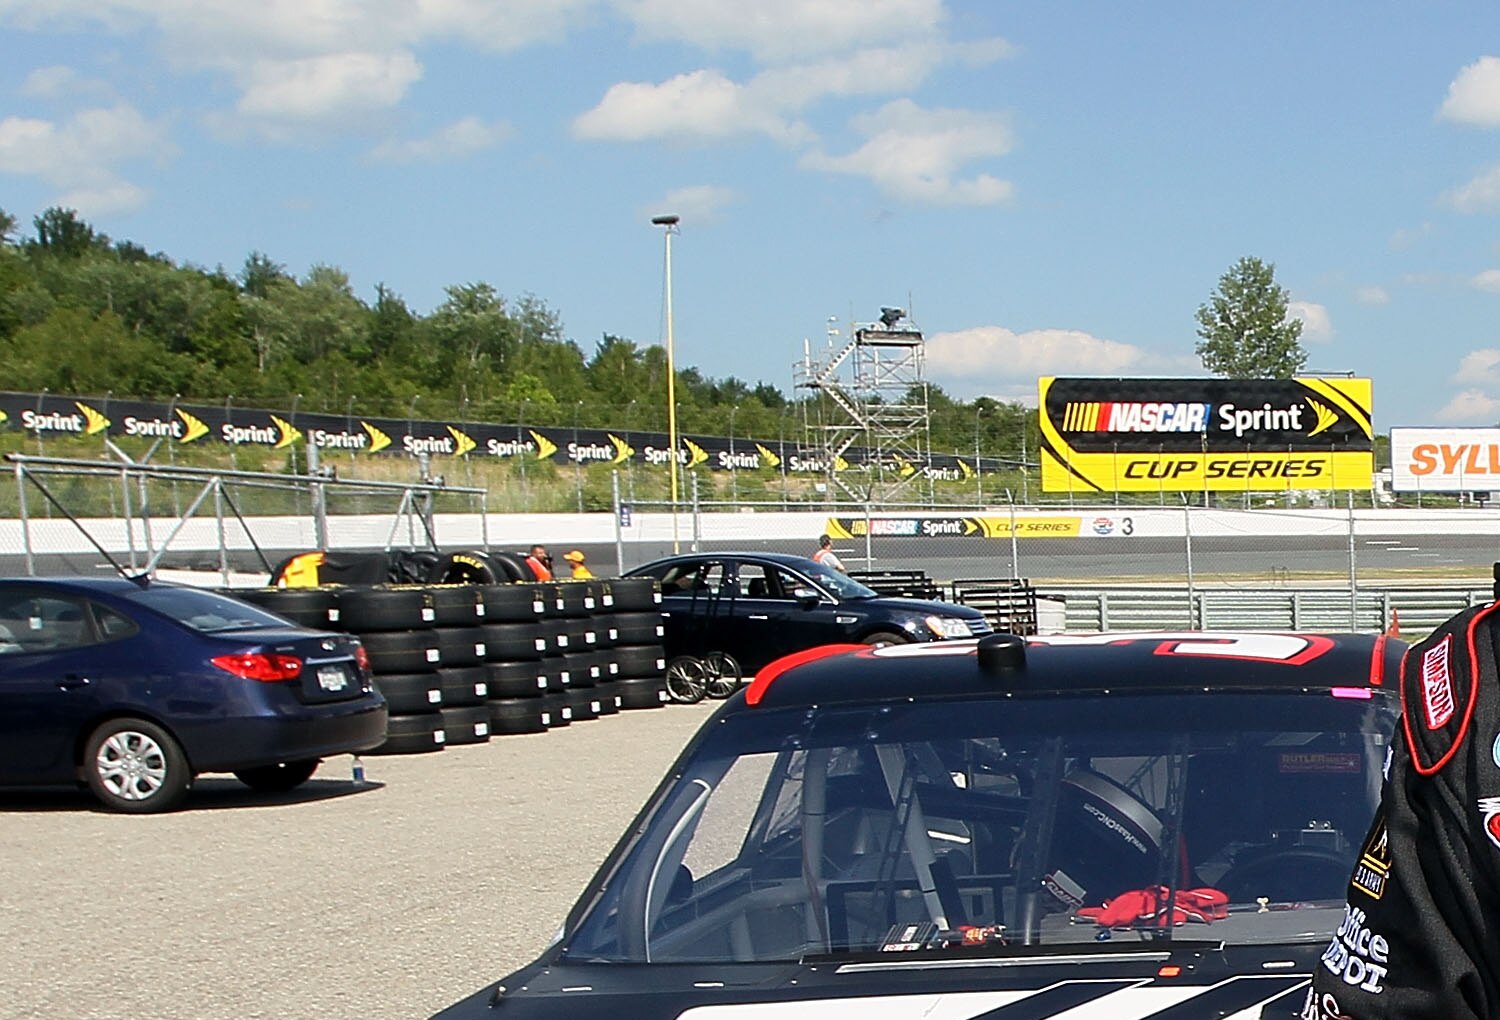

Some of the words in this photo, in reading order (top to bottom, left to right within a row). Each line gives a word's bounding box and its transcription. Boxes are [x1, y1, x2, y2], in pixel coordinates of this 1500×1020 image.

[21, 410, 83, 434] Sprint
[124, 417, 183, 437] Sprint
[1108, 402, 1206, 433] NASCAR
[1219, 403, 1304, 437] Sprint
[221, 424, 276, 444] Sprint
[315, 430, 366, 449] Sprint
[403, 435, 453, 455] Sprint
[567, 443, 613, 463] Sprint
[718, 451, 760, 470] Sprint
[1124, 460, 1198, 478] CUP
[1206, 459, 1325, 478] SERIES
[870, 520, 918, 534] NASCAR
[922, 520, 962, 537] Sprint
[1025, 522, 1072, 532] SERIES
[1426, 644, 1456, 724] SIMPSON
